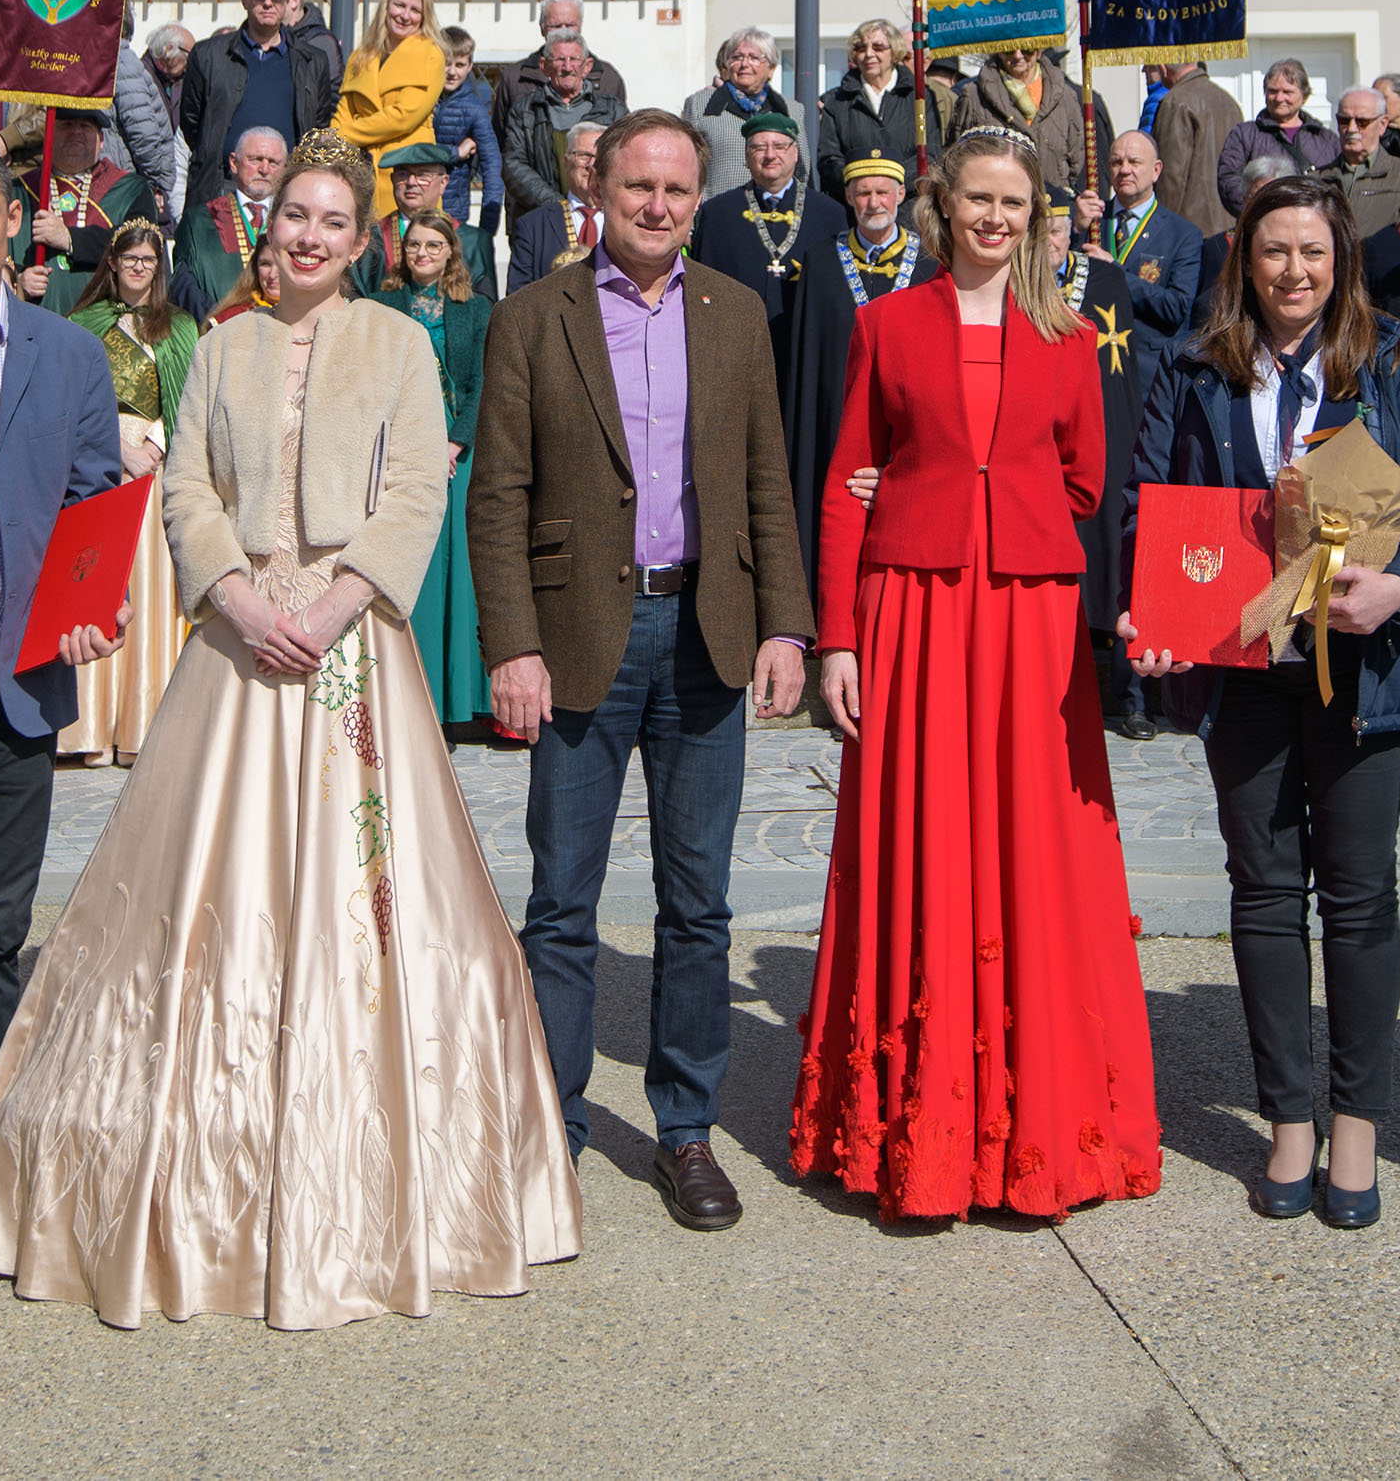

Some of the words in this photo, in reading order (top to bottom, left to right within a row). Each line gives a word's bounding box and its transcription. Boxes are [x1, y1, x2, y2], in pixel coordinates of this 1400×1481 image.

[1106, 2, 1125, 18] ZA
[932, 20, 974, 34] LEGATURA
[30, 59, 66, 72] Maribor
